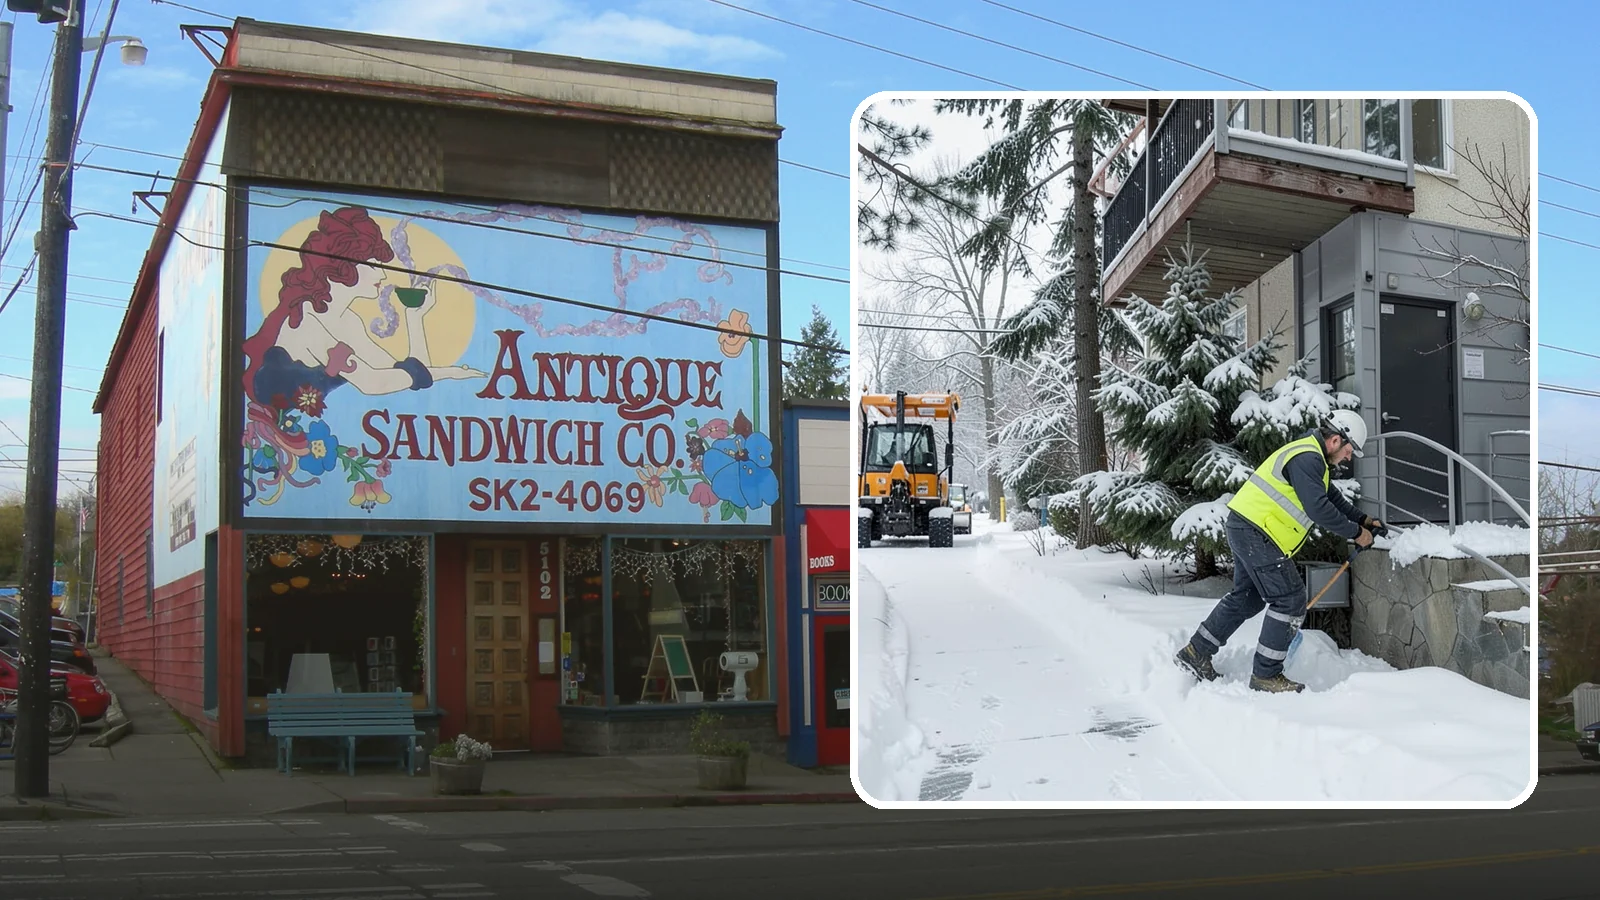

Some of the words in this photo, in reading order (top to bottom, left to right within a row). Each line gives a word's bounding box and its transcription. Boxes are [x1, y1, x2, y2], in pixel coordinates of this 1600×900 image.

[476, 328, 724, 420] ANTIQUE
[361, 408, 604, 467] SANDWICH
[617, 421, 685, 468] CO.
[467, 476, 646, 512] SK2-4069
[539, 541, 552, 600] 5102
[809, 554, 835, 569] BOOKS
